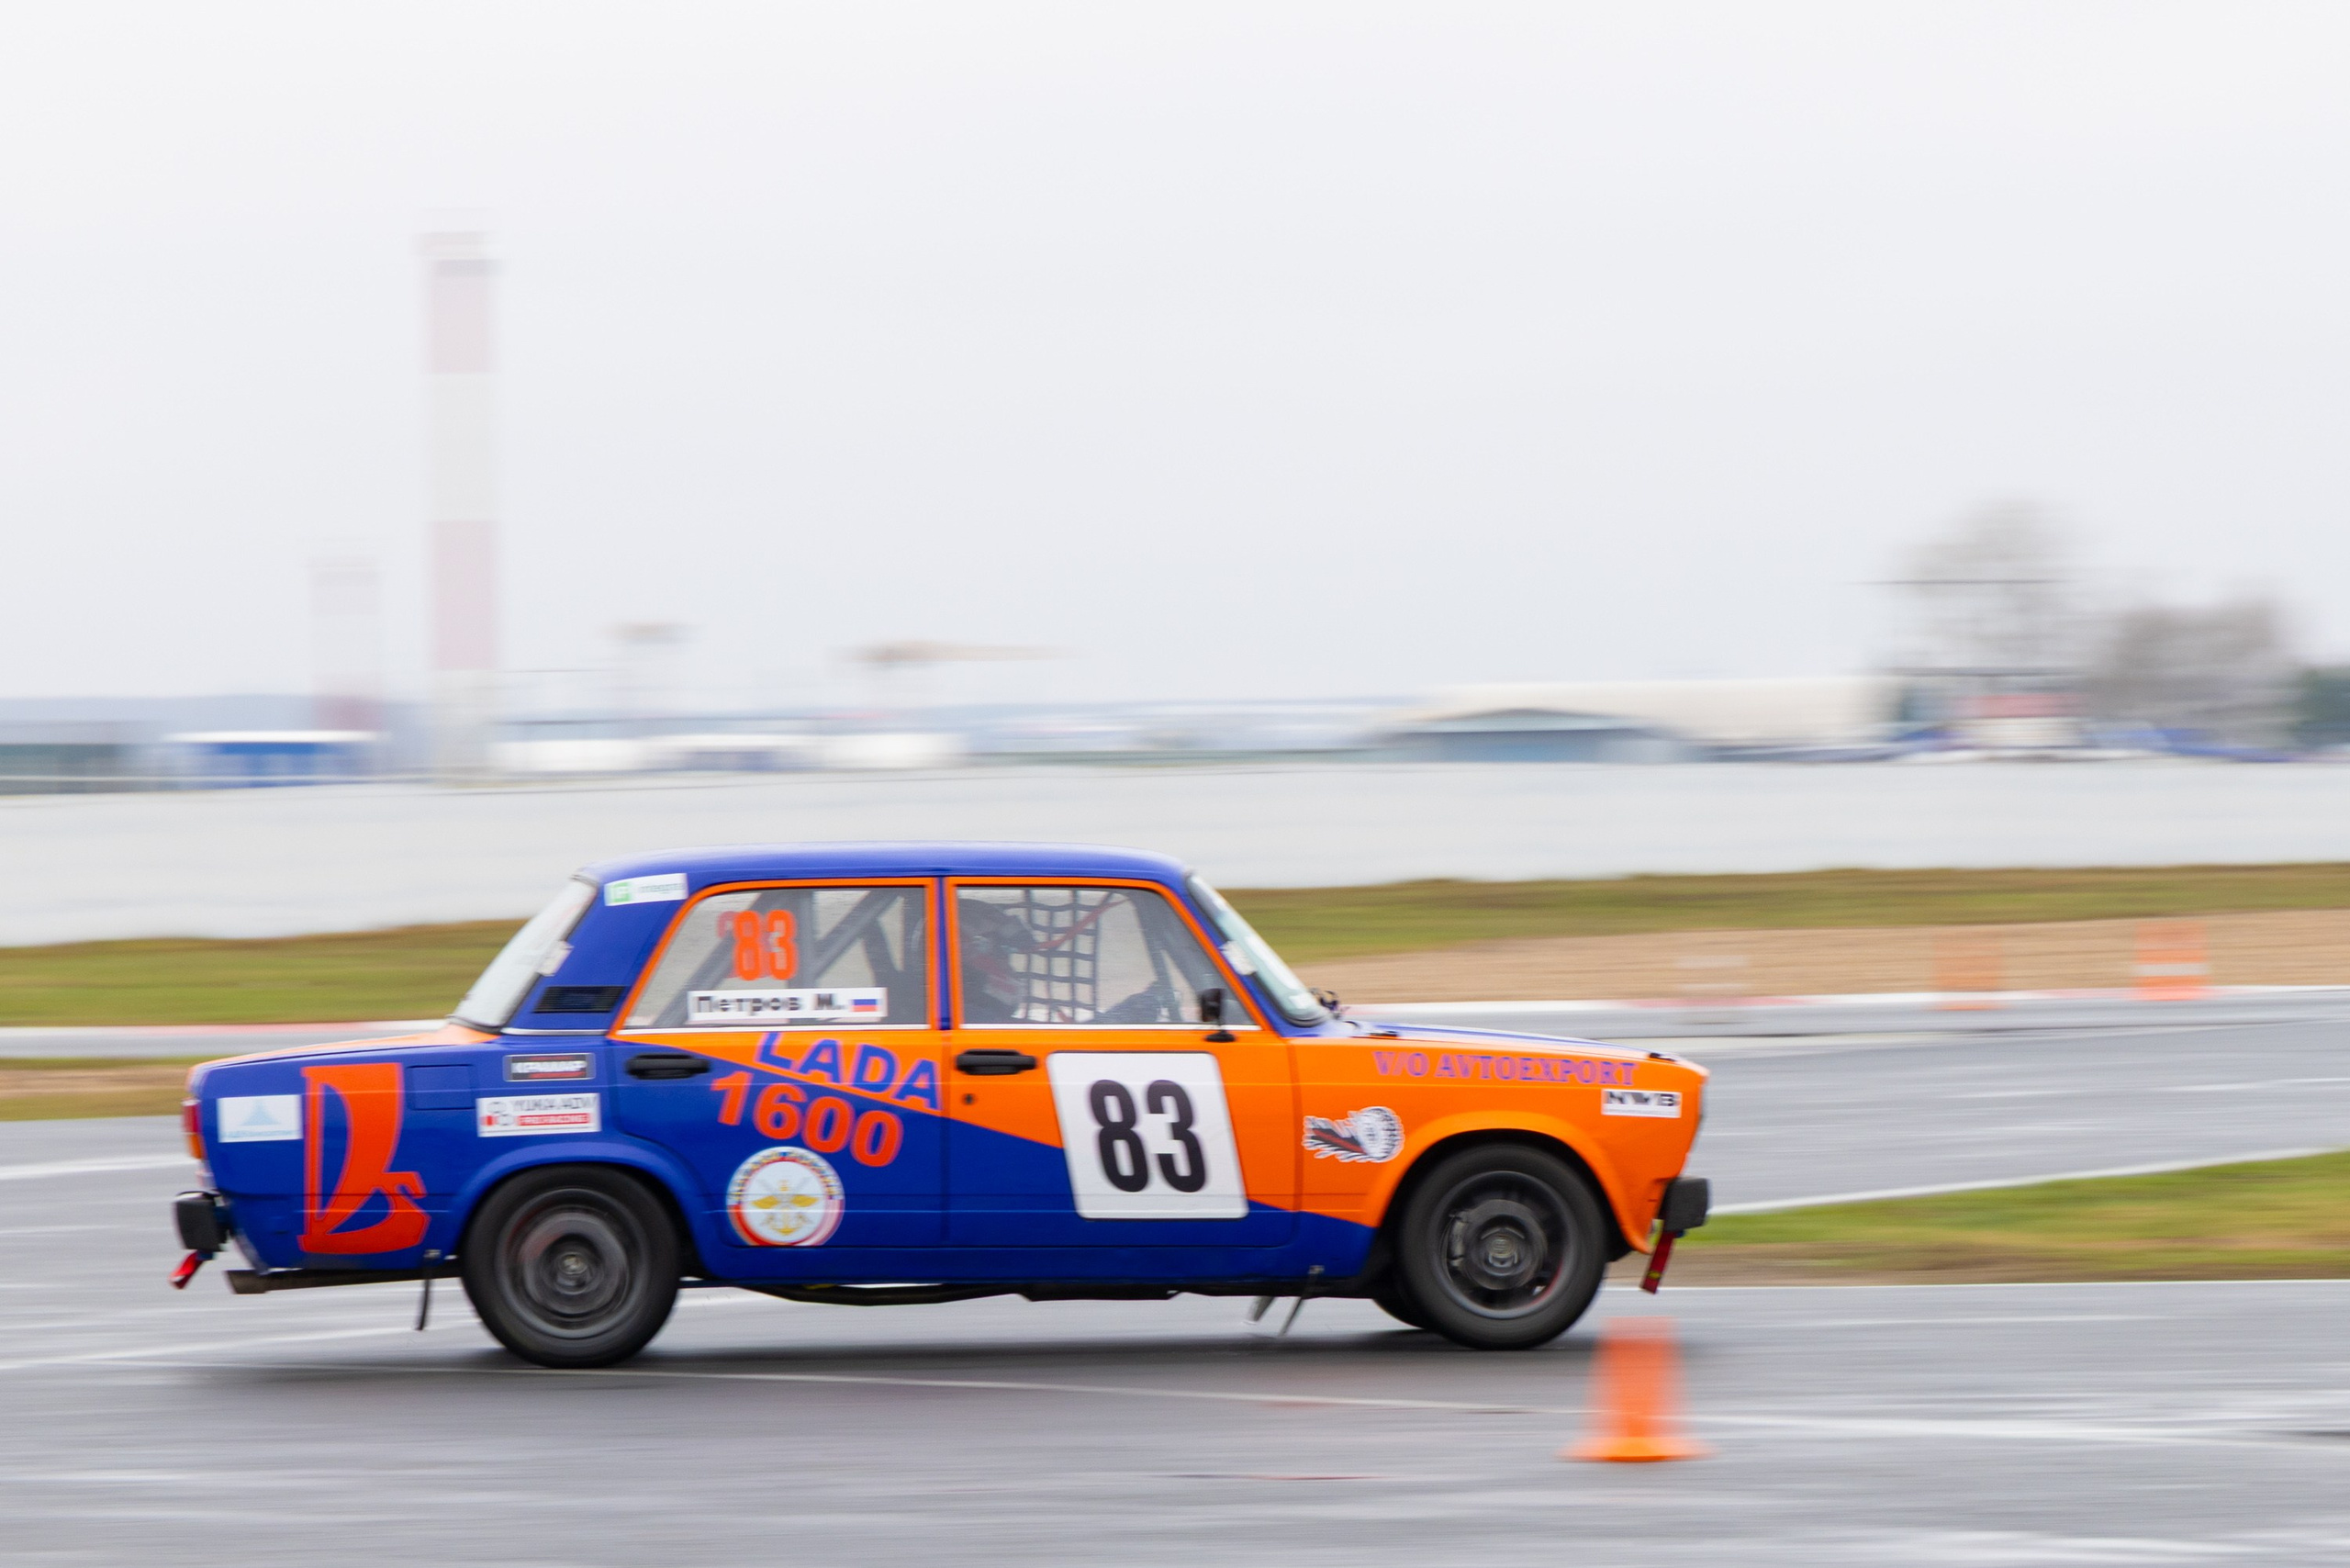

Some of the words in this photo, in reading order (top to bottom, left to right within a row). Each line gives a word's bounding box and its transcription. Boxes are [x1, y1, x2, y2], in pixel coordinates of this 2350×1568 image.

[733, 909, 799, 980] 83
[695, 995, 801, 1016] Петров
[753, 1031, 943, 1112] LADA
[1434, 1054, 1639, 1086] AVTOEXPORT
[710, 1070, 905, 1168] 1600
[1087, 1079, 1207, 1193] 83
